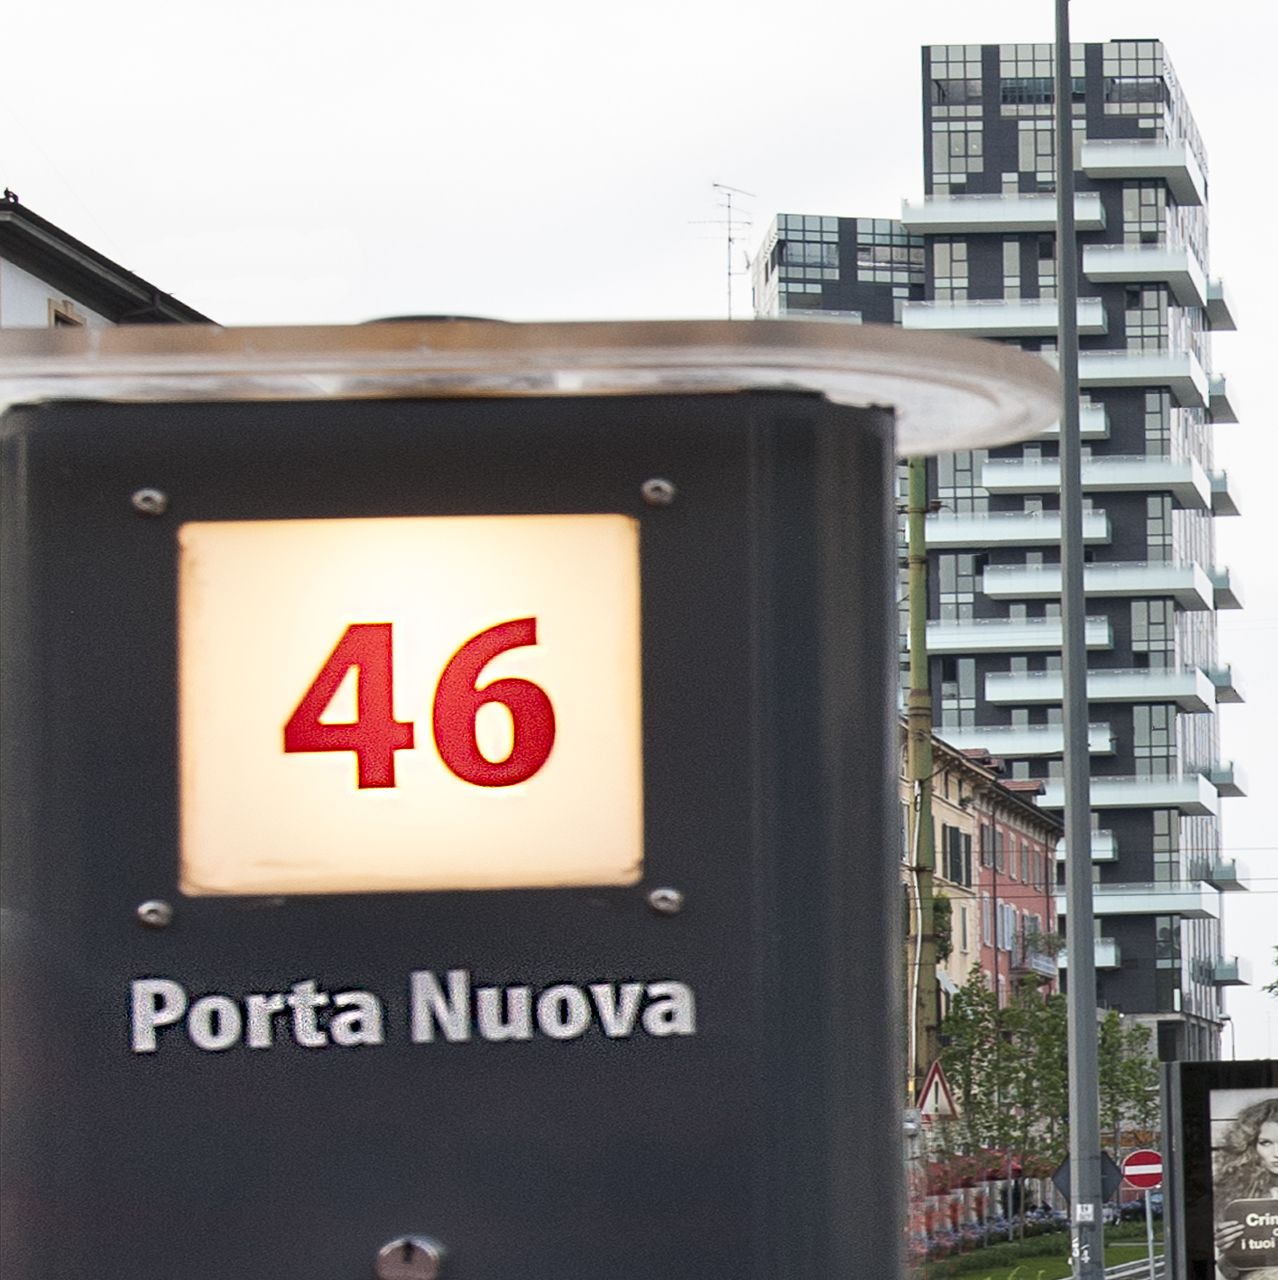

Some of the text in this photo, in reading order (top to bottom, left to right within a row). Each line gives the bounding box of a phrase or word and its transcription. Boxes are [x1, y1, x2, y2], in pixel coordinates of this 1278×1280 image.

[283, 617, 556, 789] 46
[129, 968, 697, 1055] Porta Nuova
[1241, 1239, 1246, 1250] i
[1249, 1237, 1275, 1250] tuoi
